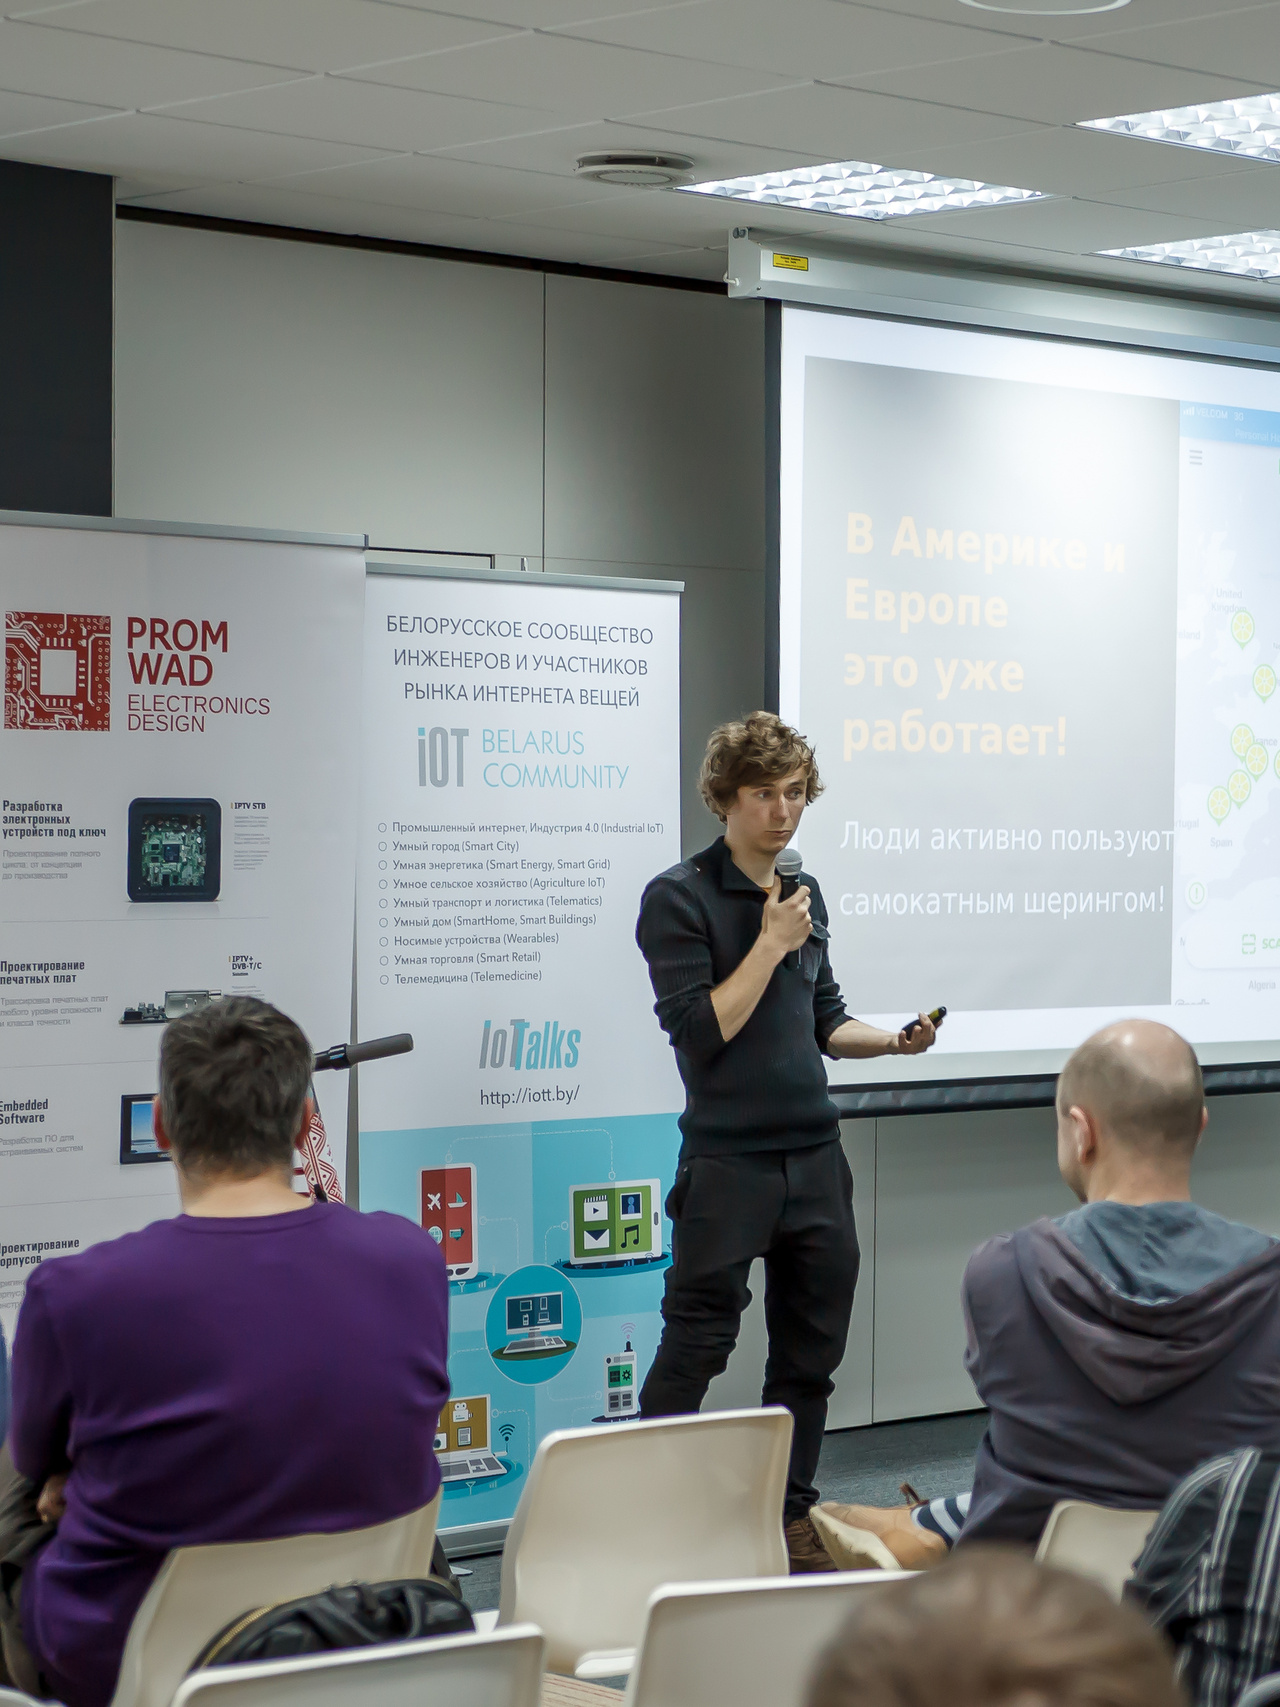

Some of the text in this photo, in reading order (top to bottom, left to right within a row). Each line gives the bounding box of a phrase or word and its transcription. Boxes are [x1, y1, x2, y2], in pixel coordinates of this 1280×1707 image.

[846, 512, 1126, 574] В Америке и
[845, 578, 1009, 633] Европе
[127, 616, 229, 653] PROM
[386, 615, 654, 645] БЕЛОРУССКОЕ СООБЩЕСТВО
[127, 652, 214, 687] WAD
[393, 649, 648, 676] ИНЖЕНЕРОВ И УЧАСТНИКОВ
[842, 652, 1025, 700] это уже
[404, 682, 640, 710] РЫНКА ИНТЕРНЕТА ВЕЩЕЙ
[128, 694, 270, 716] ELECTRONICS
[128, 714, 206, 732] DESIGN
[482, 728, 585, 755] BELARUS
[842, 708, 1068, 761] работает!
[483, 762, 630, 789] COMMUNITY
[2, 800, 63, 814] Разработка
[234, 802, 266, 810] IPTV STB
[2, 816, 70, 828] электронных
[392, 822, 664, 835] Промышленный интернет, Индустрия 4.0 (Industrial IoT)
[2, 826, 106, 840] устройств под ключ
[840, 820, 1174, 857] Люди активно пользуют
[392, 840, 520, 854] Умный город (Smart City)
[392, 858, 611, 872] Умная энергетика (Smart Energy, Smart Grid)
[392, 877, 606, 890] Умное сельское хозяйство (Agriculture IoT)
[393, 896, 603, 910] Умный транспорт и логистика (Telematics)
[840, 886, 1166, 920] самокатным шерингом!
[393, 913, 597, 928] Умный дом (SmartHome, Smart Buildings)
[394, 932, 559, 948] Носимые устройства (Wearables)
[394, 951, 541, 966] Умная торговля (Smart Retail)
[0, 961, 85, 974] Проектирование
[0, 974, 77, 985] печатных плат
[395, 970, 543, 984] Телемедицина (Telemedicine)
[480, 1084, 580, 1108] http://iott.by/
[0, 1255, 42, 1269] орпусов
